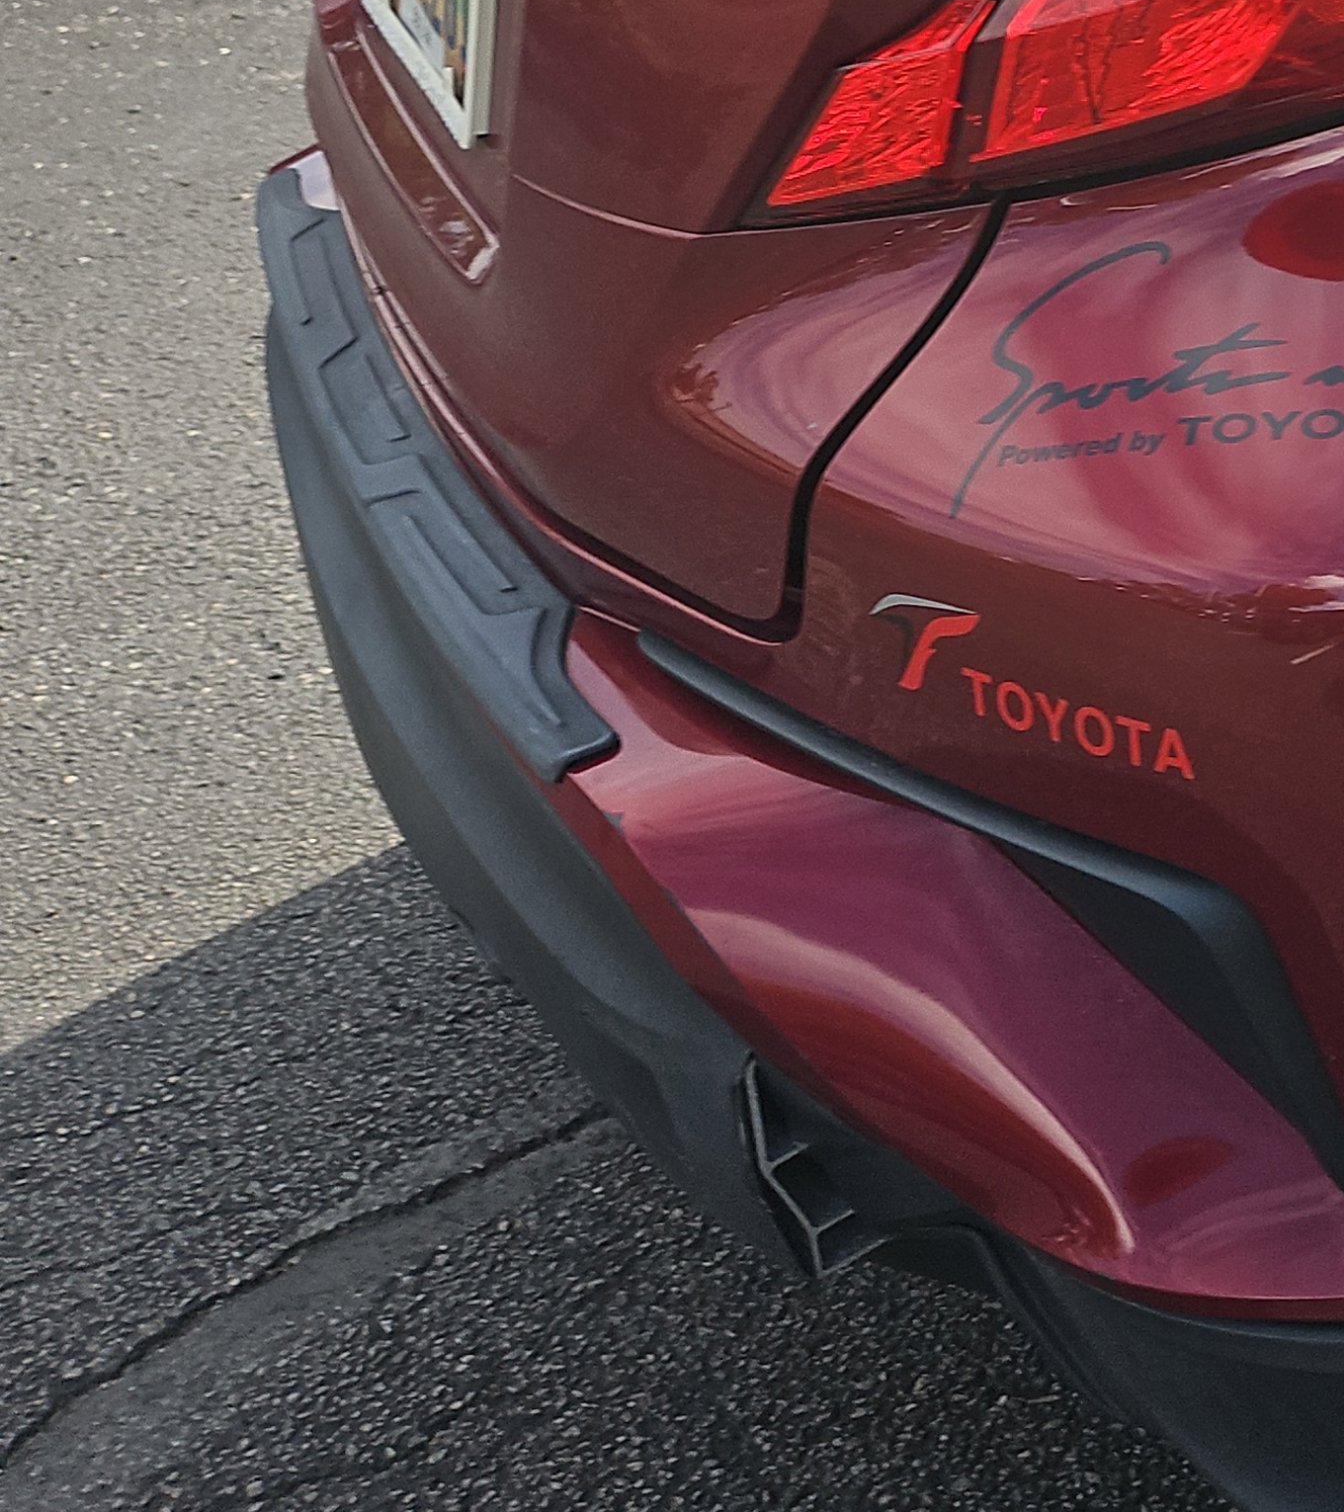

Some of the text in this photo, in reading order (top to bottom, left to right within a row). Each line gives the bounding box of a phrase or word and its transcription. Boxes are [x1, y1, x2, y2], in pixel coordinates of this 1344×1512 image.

[997, 431, 1123, 467] Powered
[1127, 430, 1164, 456] by
[961, 667, 1195, 780] TOYOTA
